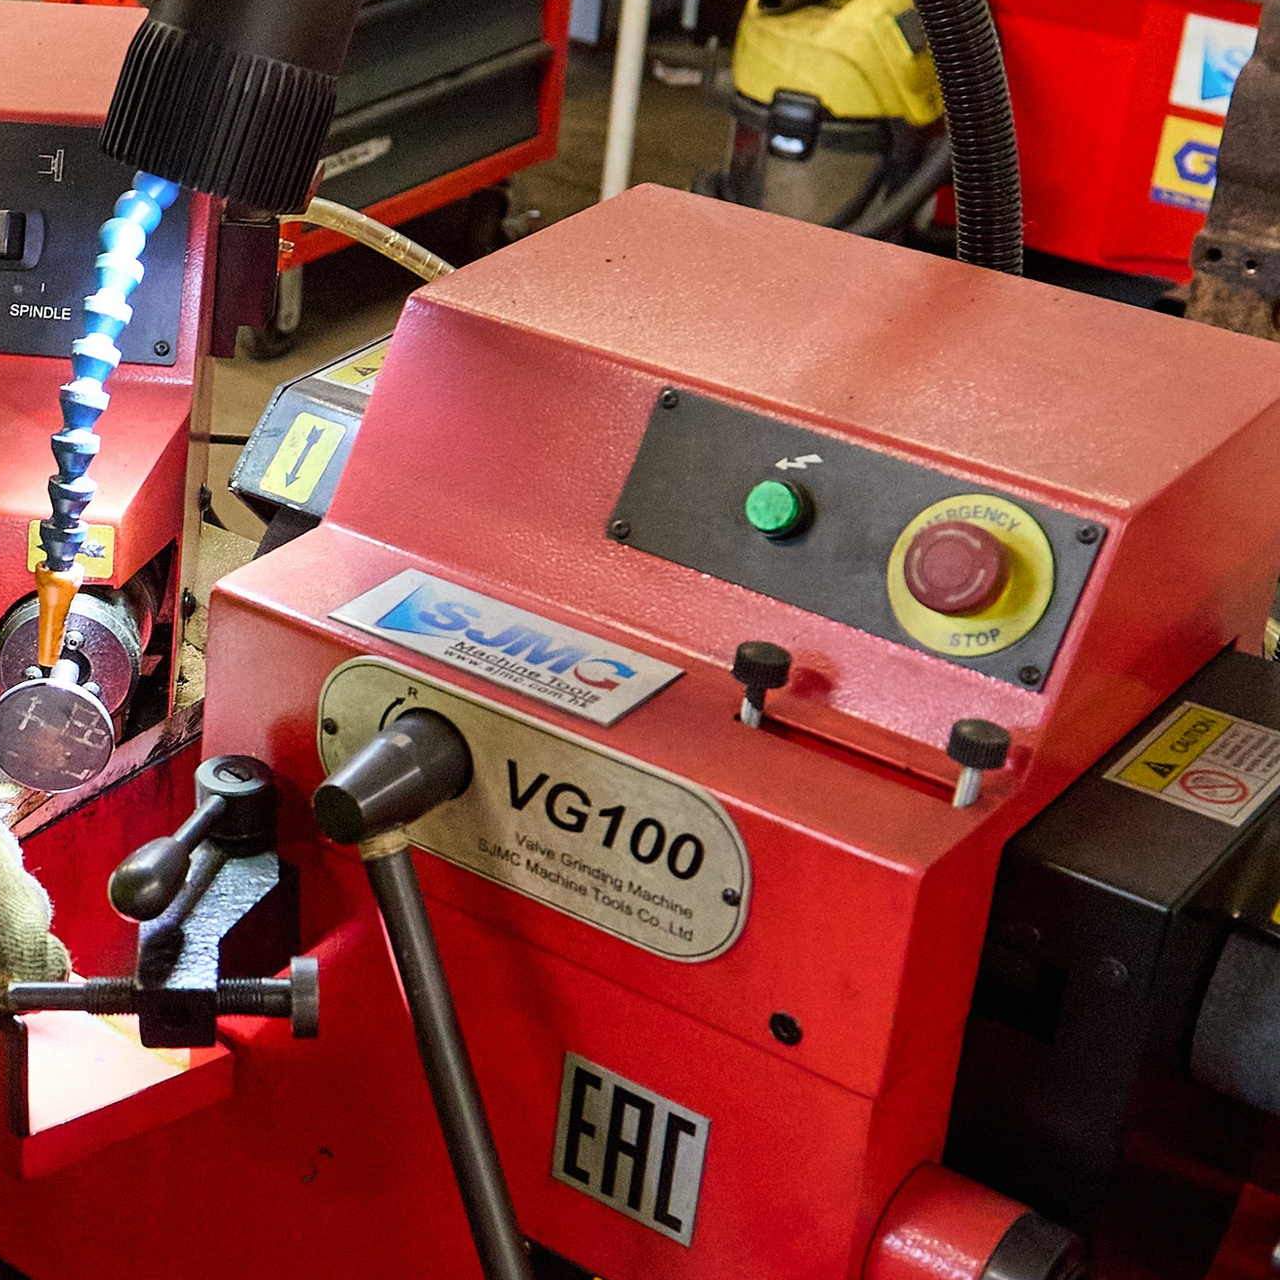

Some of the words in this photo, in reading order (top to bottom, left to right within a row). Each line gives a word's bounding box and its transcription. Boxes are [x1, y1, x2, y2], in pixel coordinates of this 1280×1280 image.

[9, 304, 72, 320] SPINDLE
[454, 640, 541, 680] Machine
[549, 675, 601, 704] Tools
[949, 628, 1000, 648] STOP
[407, 686, 418, 700] R
[506, 758, 705, 881] VG100
[478, 837, 521, 867] SJMC
[526, 858, 588, 897] Machine
[592, 886, 634, 917] Tools
[515, 832, 556, 861] Valve
[561, 851, 624, 894] Grinding
[628, 880, 694, 920] Machine
[563, 1066, 697, 1233] EAC
